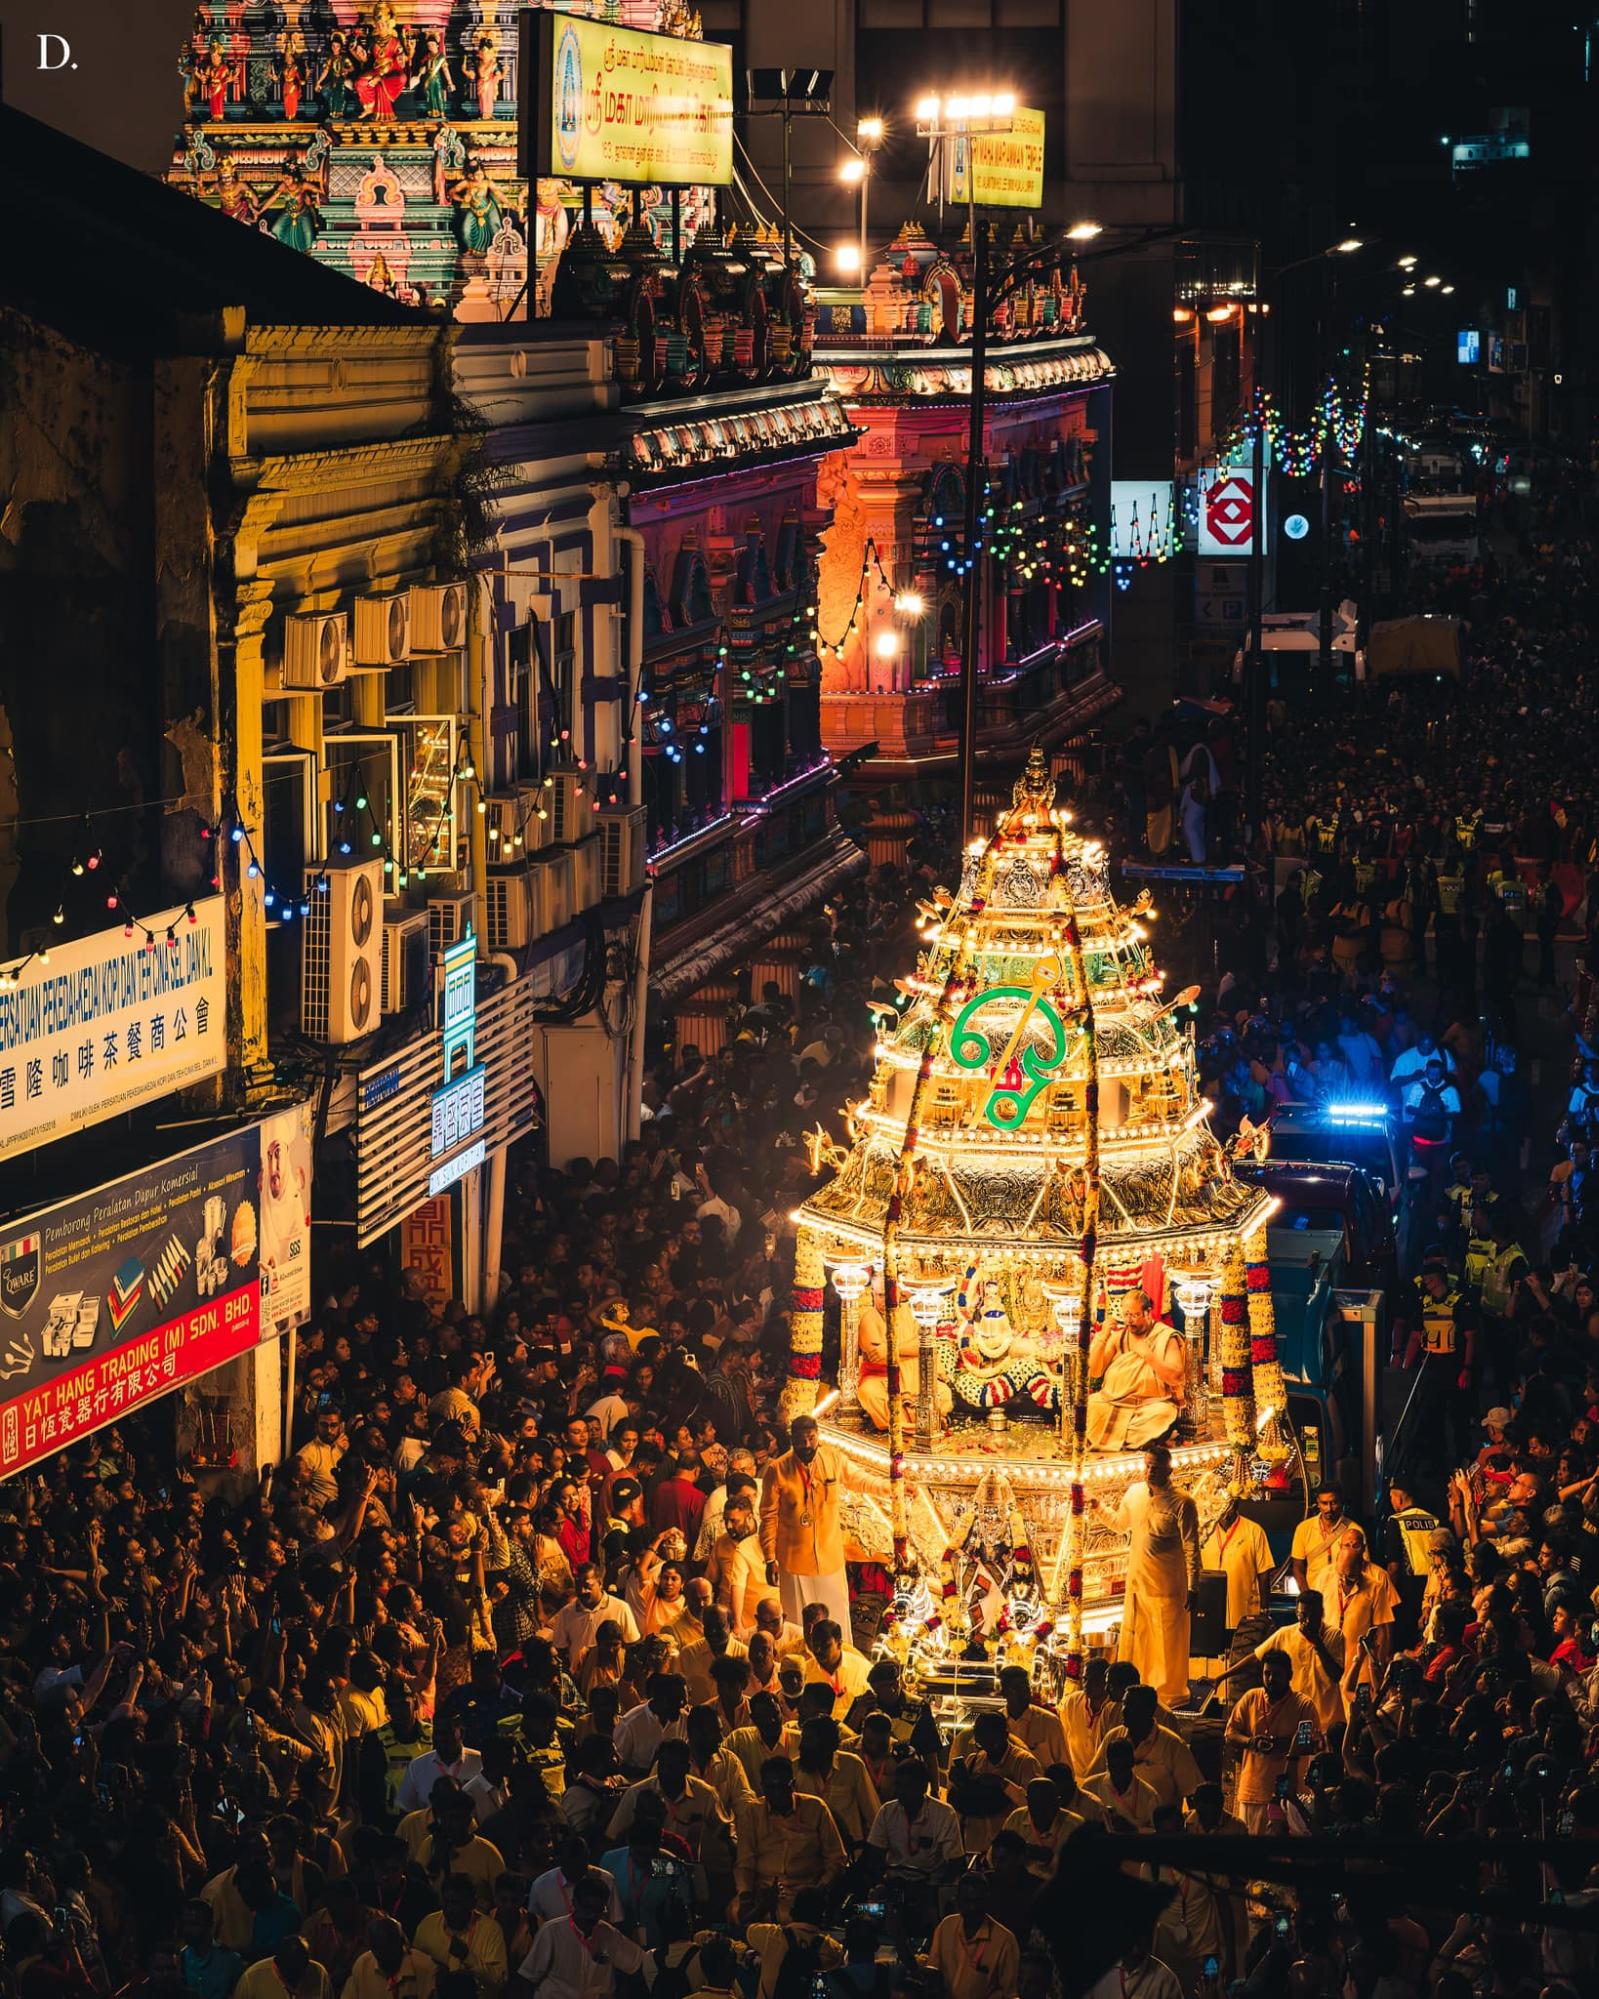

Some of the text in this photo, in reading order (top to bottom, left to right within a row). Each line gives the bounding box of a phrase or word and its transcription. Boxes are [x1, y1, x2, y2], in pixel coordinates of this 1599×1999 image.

[121, 949, 137, 1009] DAN
[0, 996, 209, 1111] 雪隆咖啡茶餐商公會
[45, 1163, 198, 1244] Pemborong Peralatan Dapur Komersial
[23, 1391, 51, 1423] YAT
[57, 1368, 95, 1408] HANG
[100, 1336, 159, 1384] TRADING
[164, 1322, 185, 1355] (M)
[190, 1308, 220, 1341] SDN.
[225, 1293, 254, 1323] BHD.
[1405, 1519, 1435, 1530] POLIS
